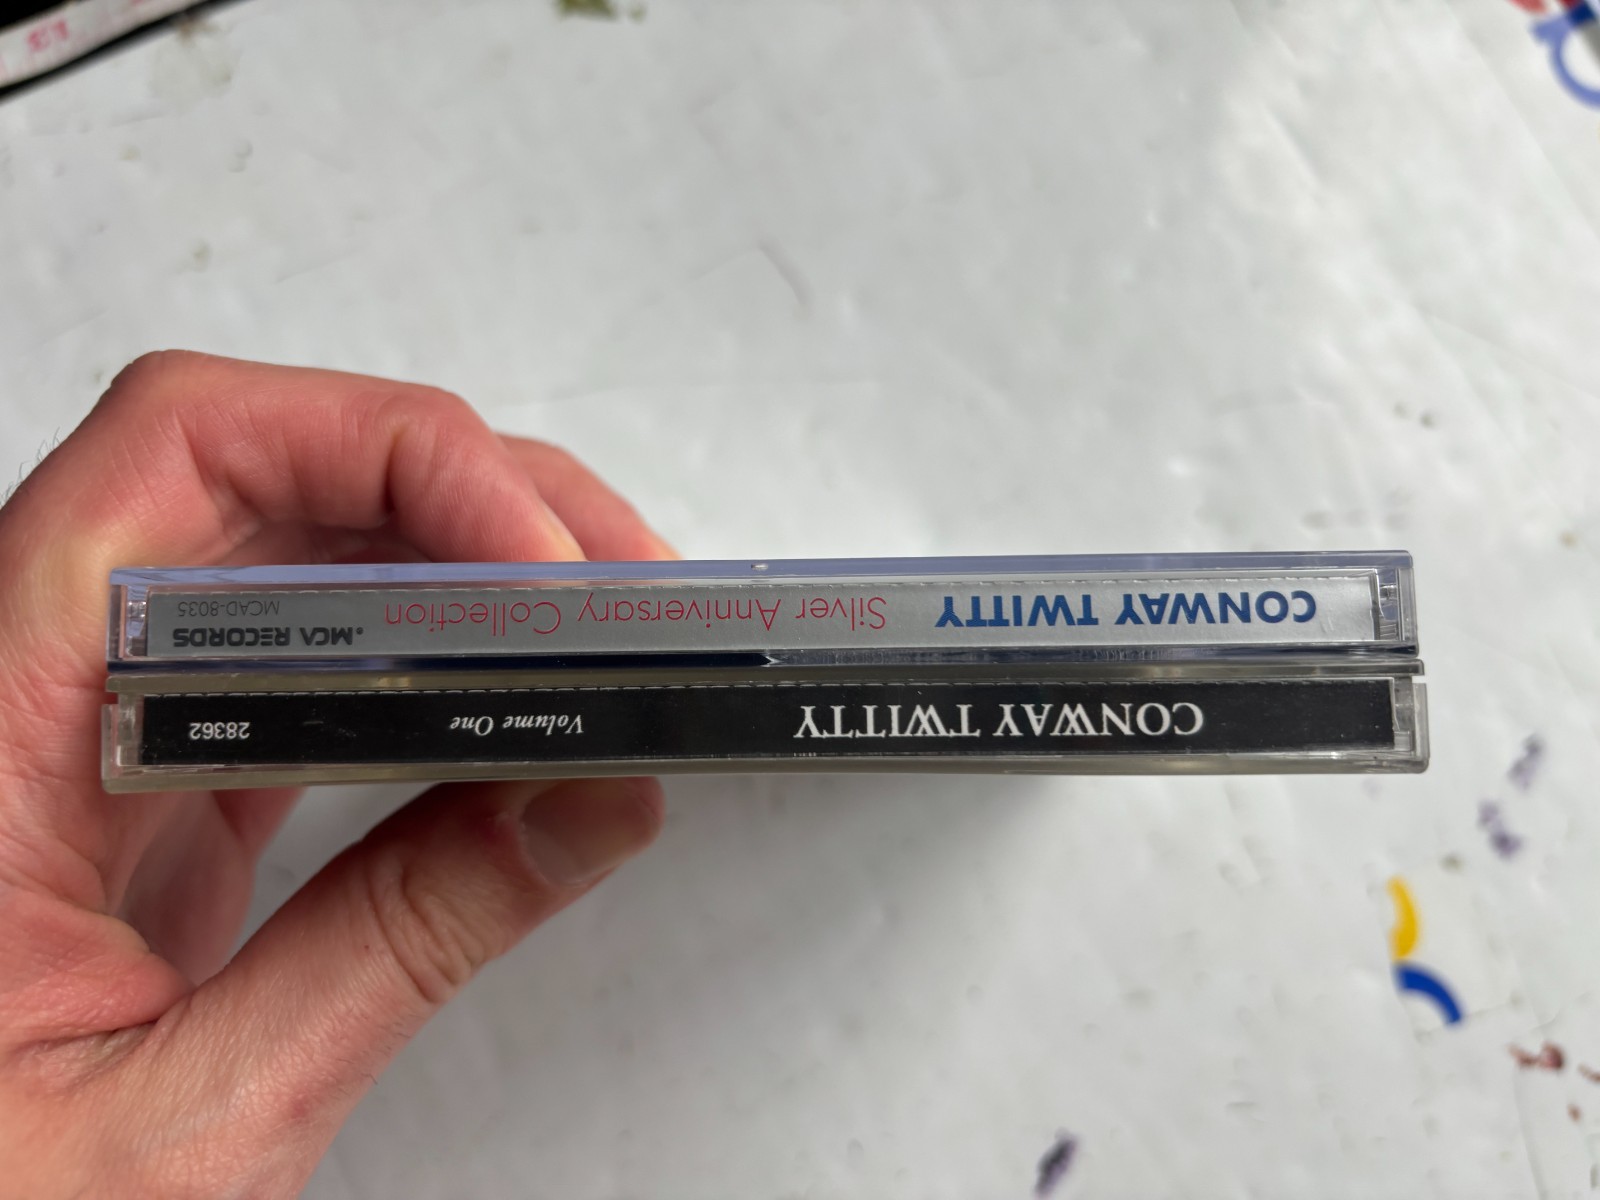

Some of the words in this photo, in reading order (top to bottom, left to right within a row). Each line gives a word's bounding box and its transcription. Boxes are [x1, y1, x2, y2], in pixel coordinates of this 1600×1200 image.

[177, 600, 280, 617] MCAD-8035
[384, 600, 561, 636] Collection
[577, 592, 781, 631] Anniversary
[795, 596, 887, 631] Silver
[934, 594, 1099, 628] TWITTY
[1114, 590, 1317, 625] CONWAY
[172, 627, 291, 647] RECORDS
[188, 720, 251, 740] 28362
[449, 715, 494, 736] One
[502, 714, 584, 736] Volume
[793, 703, 981, 739] TWITTY
[992, 702, 1204, 737] CONWAY
